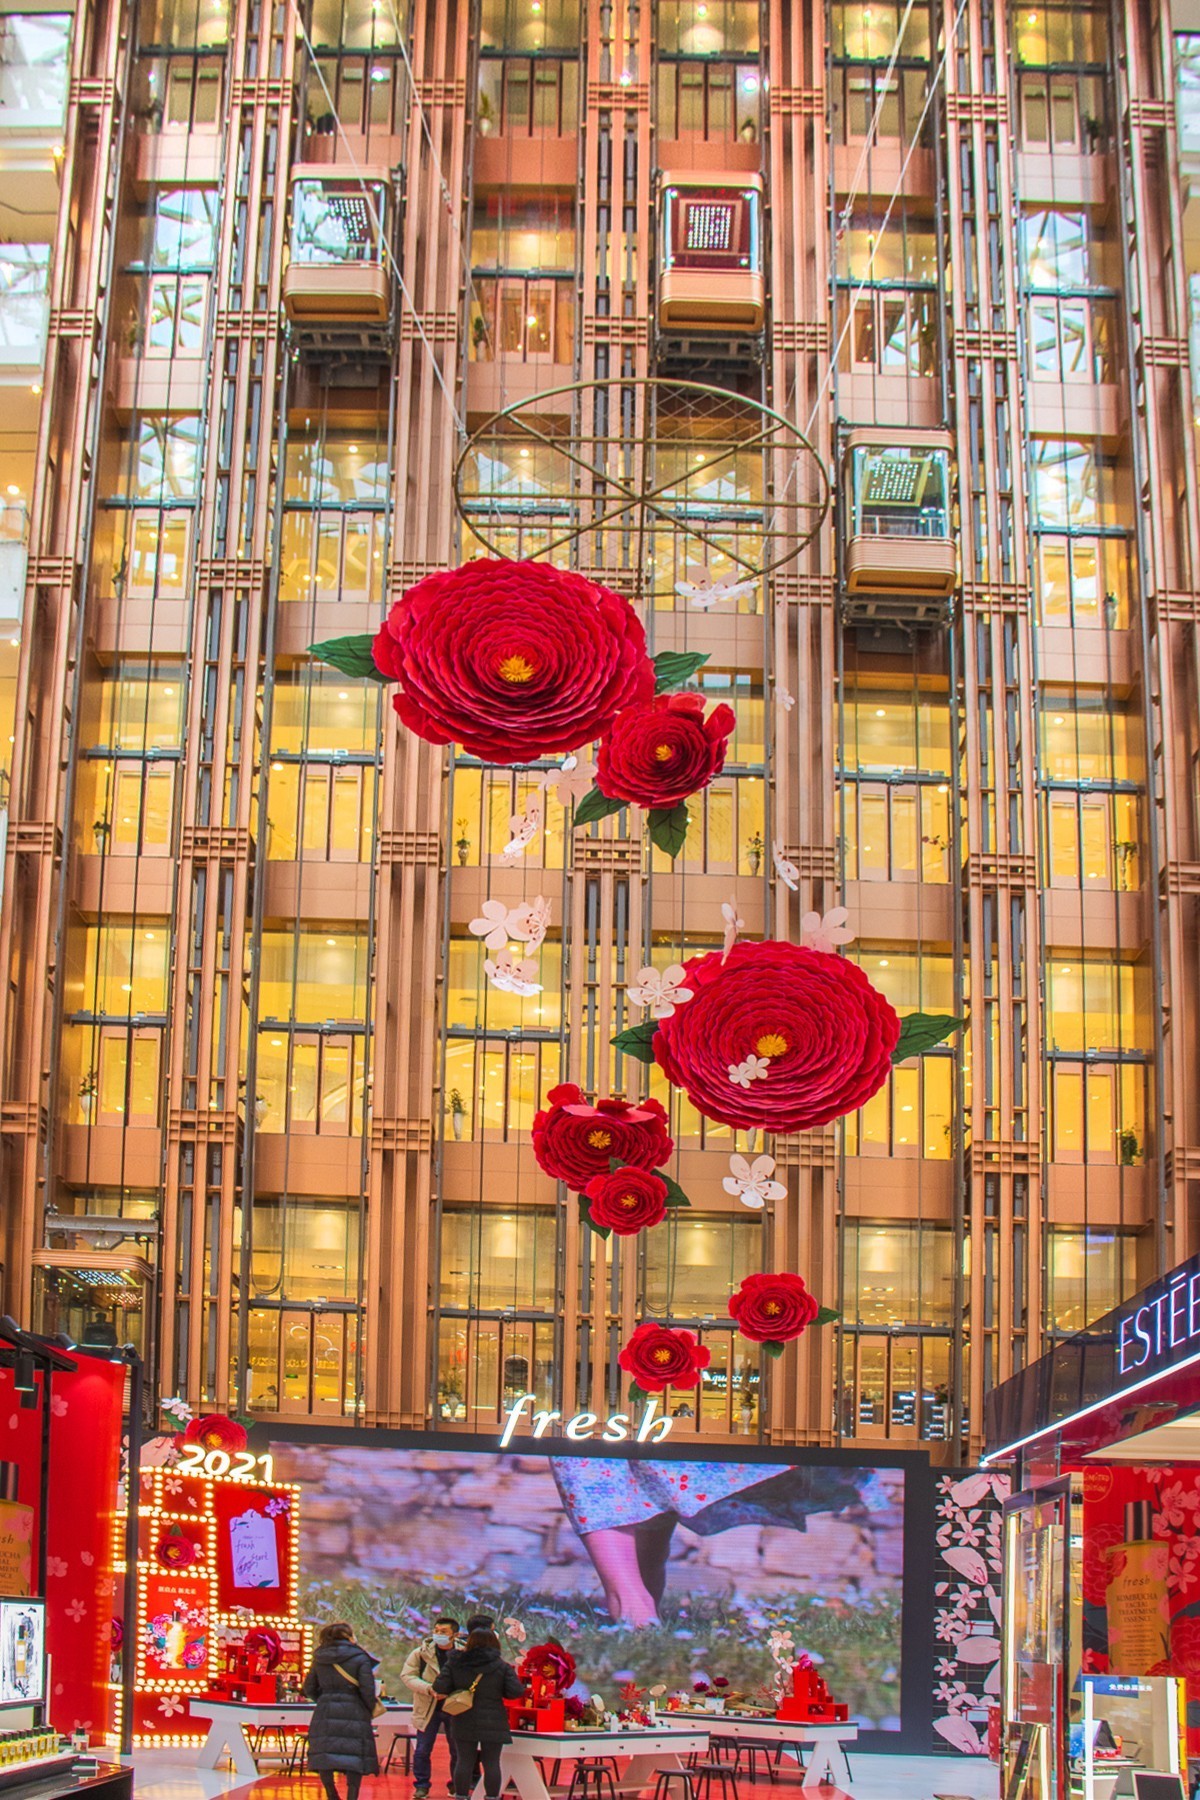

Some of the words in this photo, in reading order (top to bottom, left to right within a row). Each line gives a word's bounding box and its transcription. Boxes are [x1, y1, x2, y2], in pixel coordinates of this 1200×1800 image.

[500, 1394, 673, 1447] fresh
[176, 1444, 273, 1483] 2021
[1123, 1574, 1150, 1589] fresh
